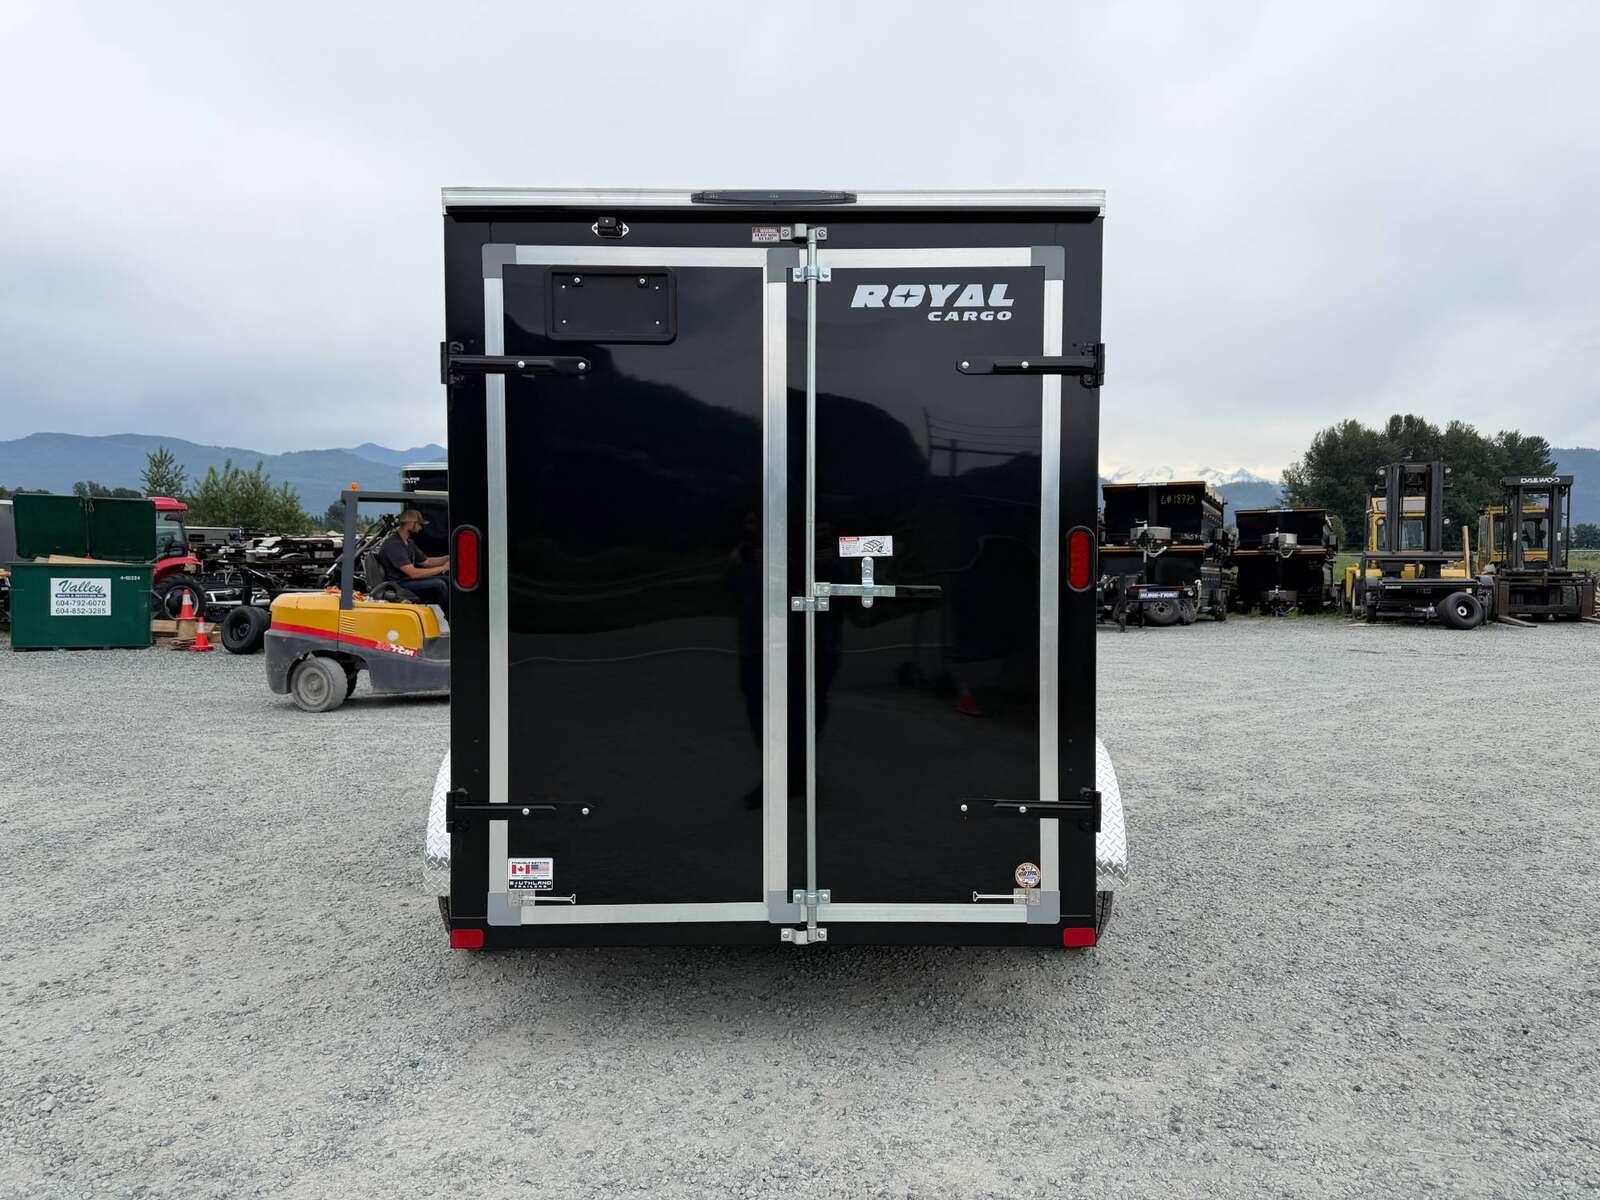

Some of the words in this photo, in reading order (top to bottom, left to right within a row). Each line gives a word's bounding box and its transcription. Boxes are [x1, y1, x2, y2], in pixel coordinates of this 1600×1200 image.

[850, 284, 1015, 308] ROYAL
[927, 311, 1012, 321] CARGO
[1520, 476, 1560, 484] DAEWOO
[58, 580, 104, 594] Valley
[390, 643, 414, 657] TCM
